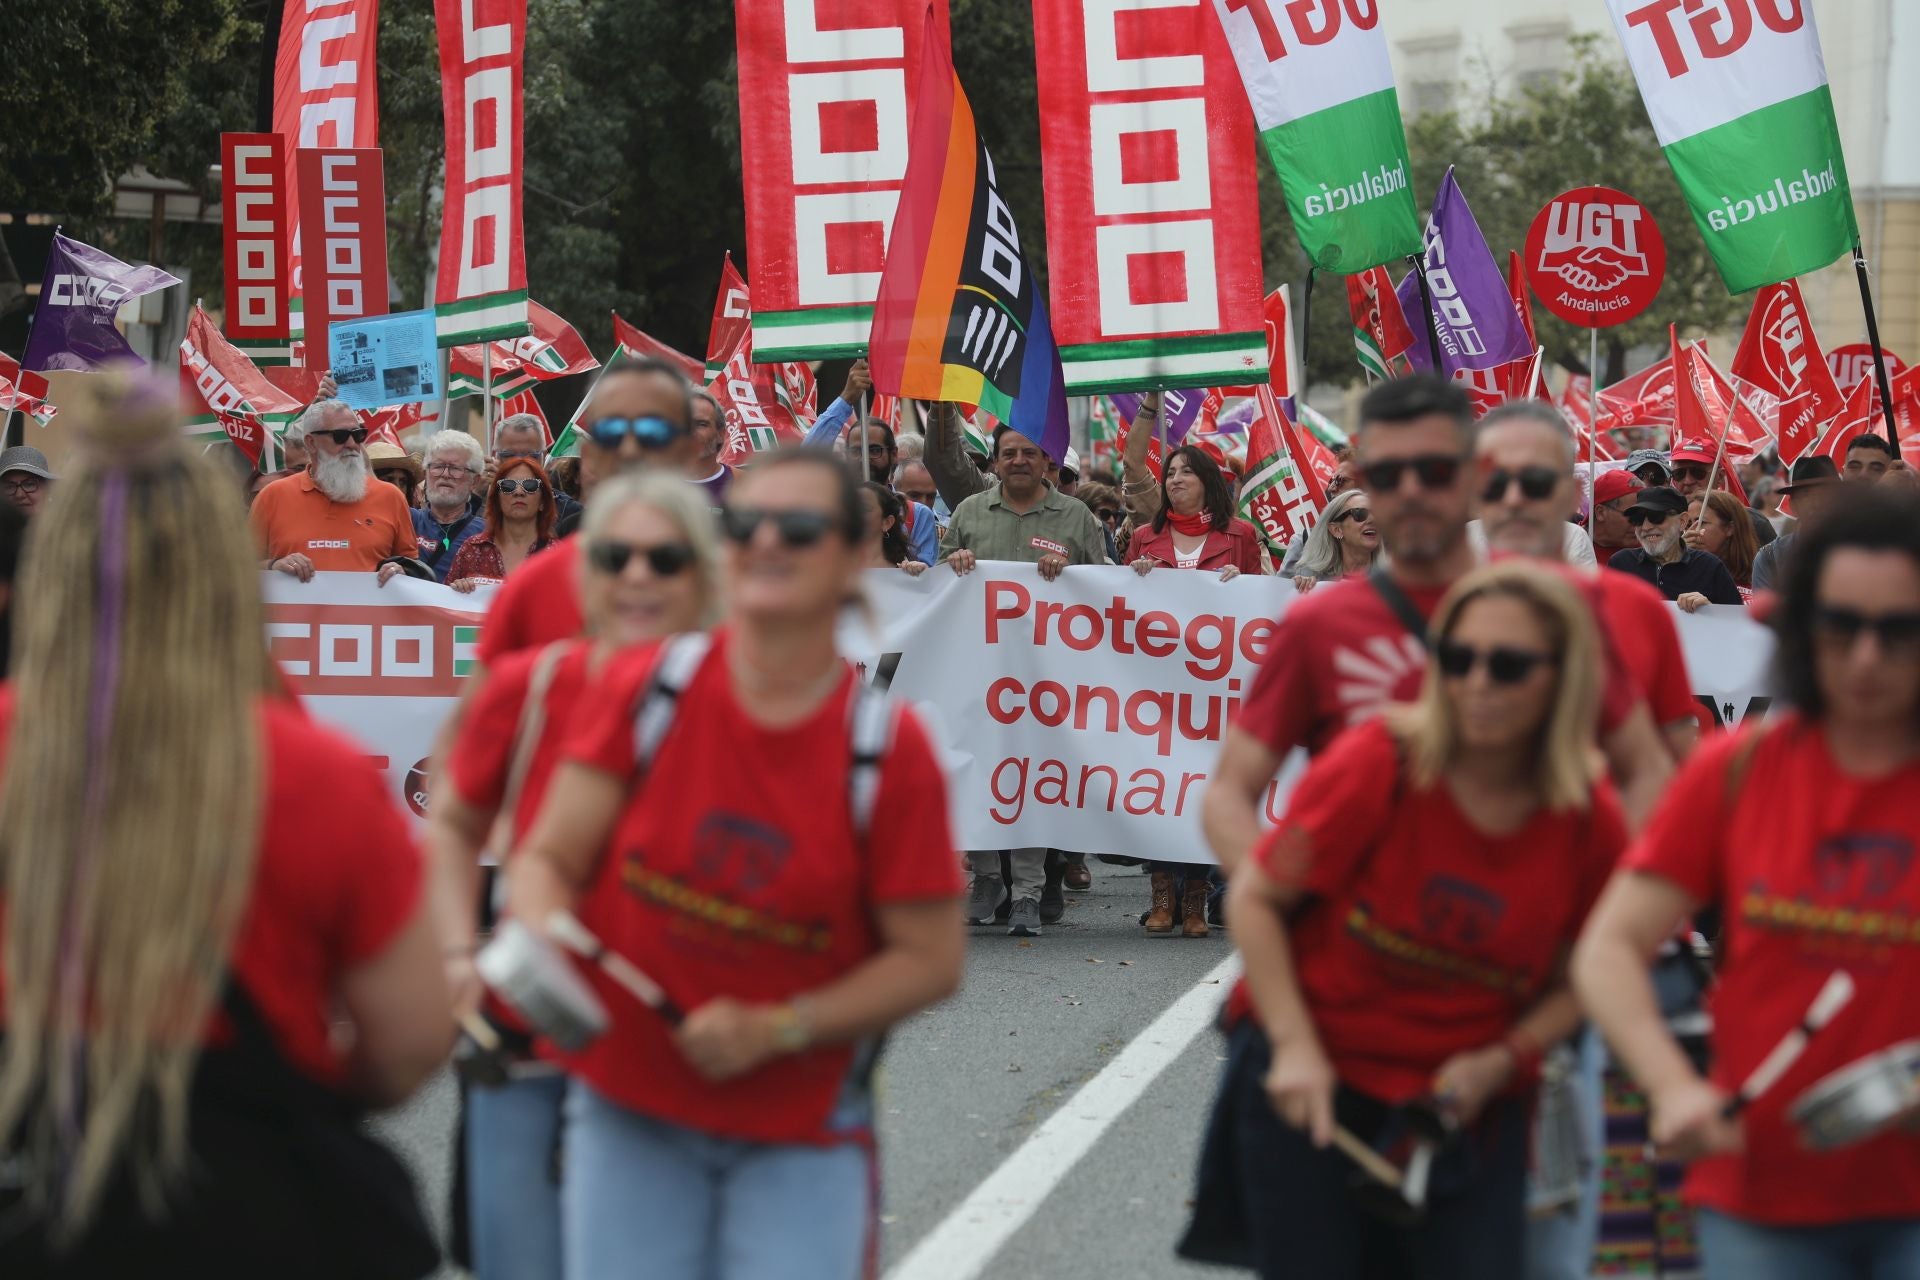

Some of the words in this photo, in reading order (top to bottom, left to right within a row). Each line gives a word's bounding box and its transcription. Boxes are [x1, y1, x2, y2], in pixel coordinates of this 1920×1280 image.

[235, 145, 277, 327] CCOO
[321, 155, 363, 314] CCOO
[1544, 202, 1642, 255] UGT
[1557, 291, 1631, 312] Andalucía
[308, 540, 340, 549] CCOO
[1032, 538, 1062, 553] CCOO
[266, 623, 434, 677] COO
[989, 756, 1207, 825] ganar
